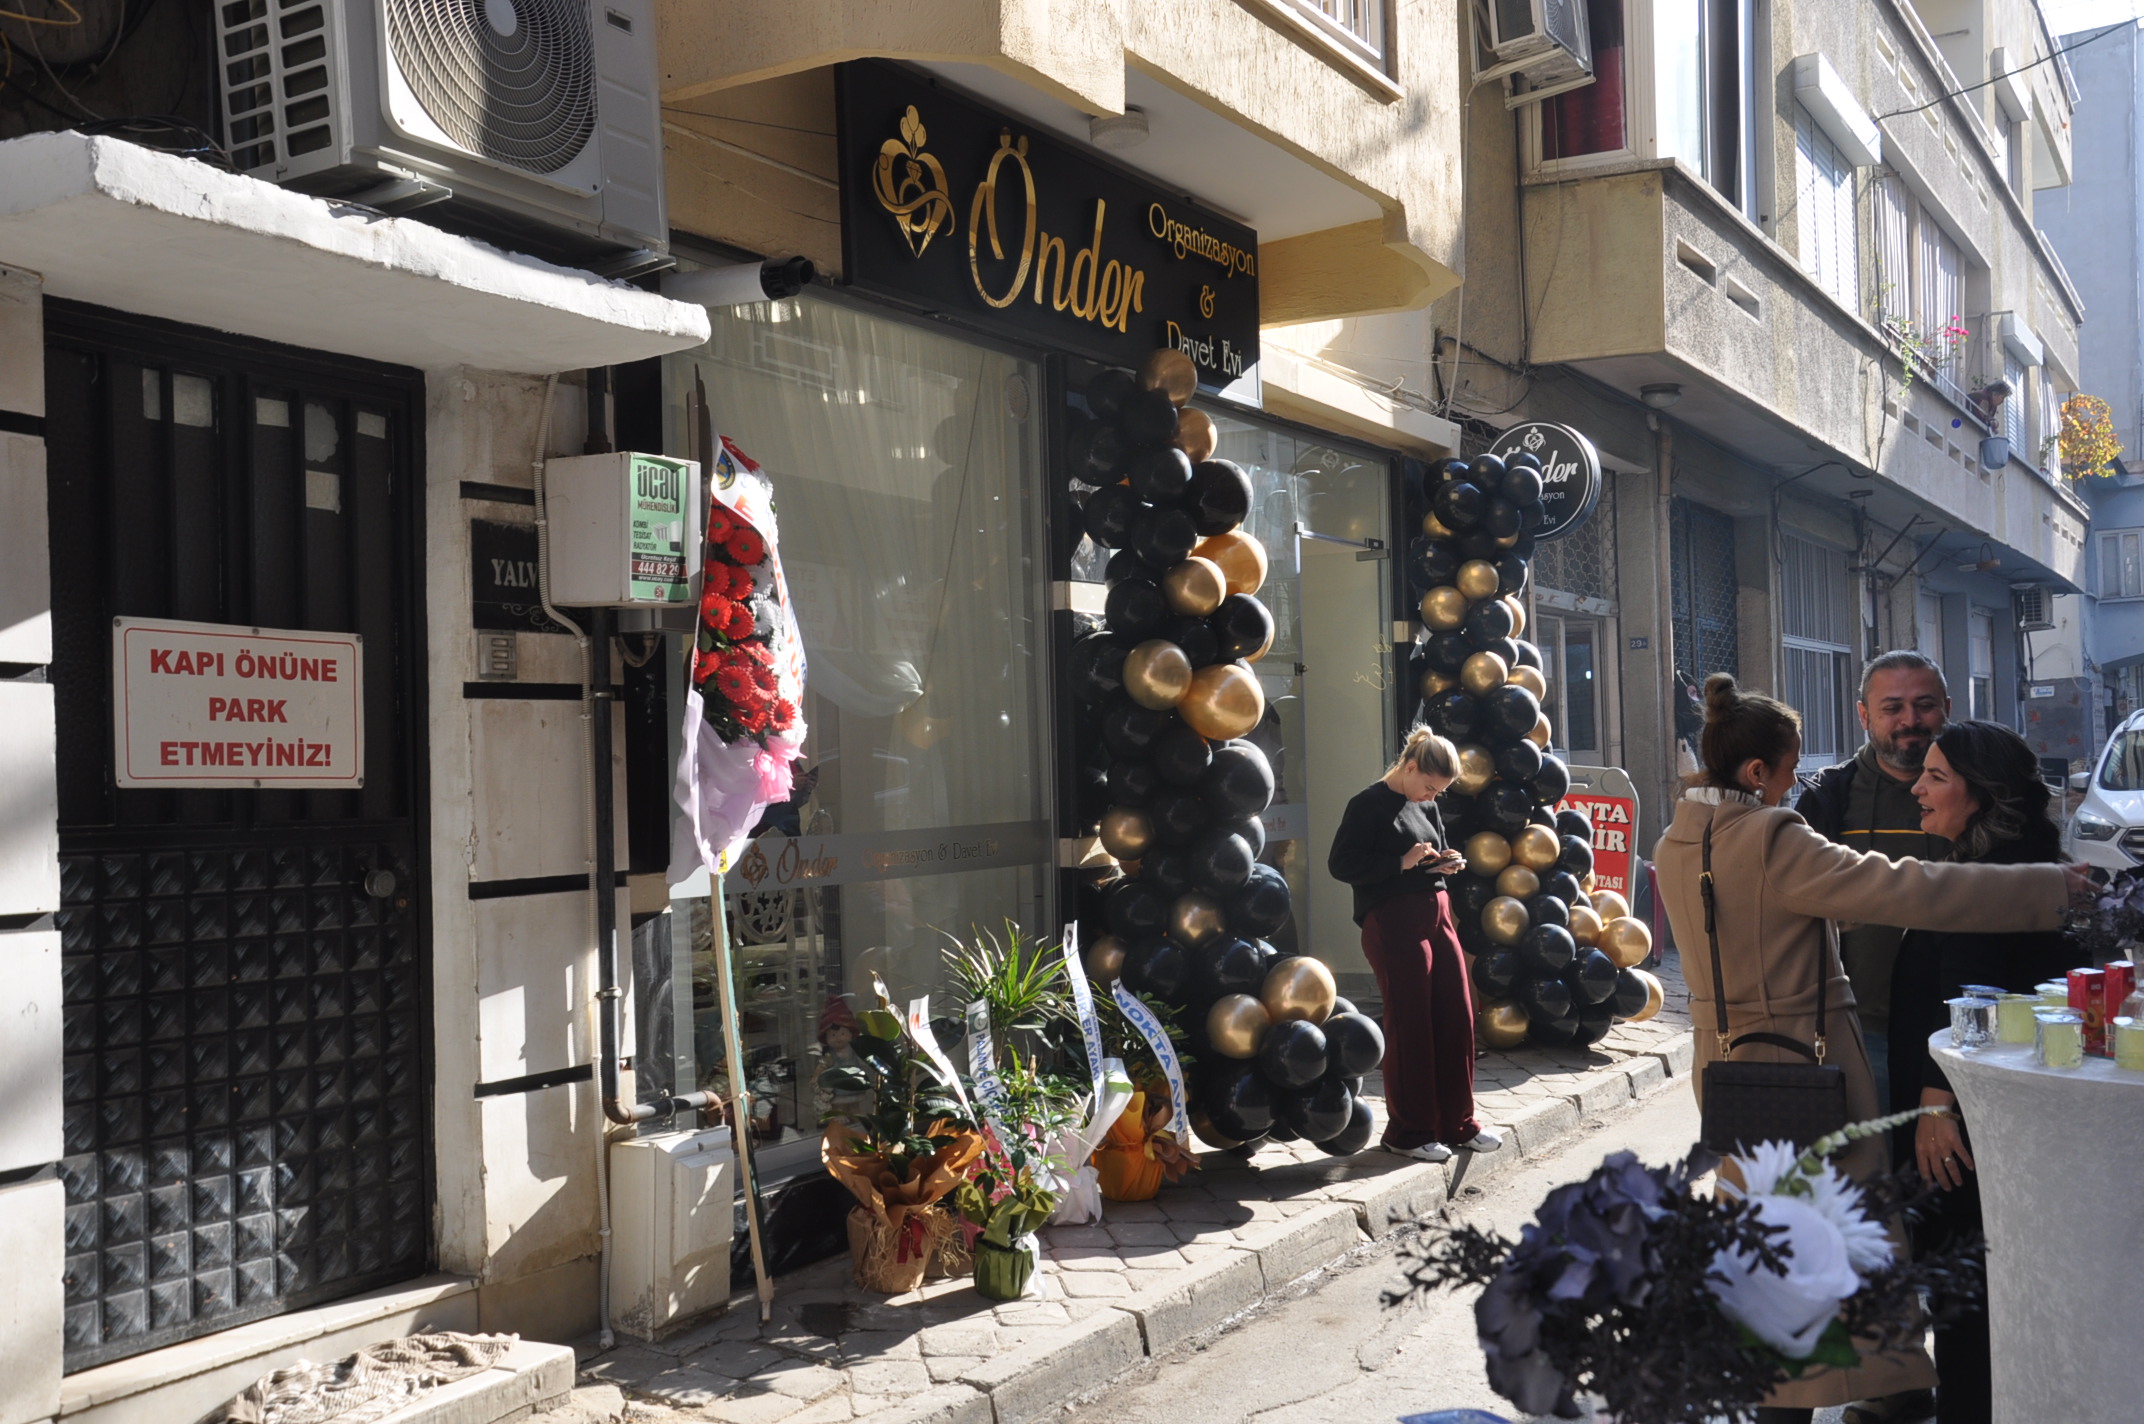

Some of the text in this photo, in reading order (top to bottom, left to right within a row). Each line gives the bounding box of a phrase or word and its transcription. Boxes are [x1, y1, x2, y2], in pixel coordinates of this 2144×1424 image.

[968, 126, 1145, 333] Önder
[1148, 202, 1256, 278] Organizasyon
[1199, 284, 1216, 319] &
[1166, 320, 1243, 378] Davet Evi
[637, 499, 676, 514] MÜHENDİSLİK
[1543, 514, 1556, 524] Evi
[633, 520, 648, 528] KOMBİ
[633, 531, 652, 540] TESİSAT
[633, 542, 657, 551] RADYATÖR
[638, 561, 679, 576] 444 82 29
[150, 647, 338, 683] KAPI ÖNÜNE
[208, 696, 288, 724] PARK
[160, 736, 332, 768] ETMEYİNİZ!
[1555, 799, 1630, 824] ANTA
[776, 838, 838, 885] Önder
[953, 841, 982, 860] Davet
[1115, 993, 1172, 1072] NOKTA
[1171, 1078, 1184, 1132] AVM
